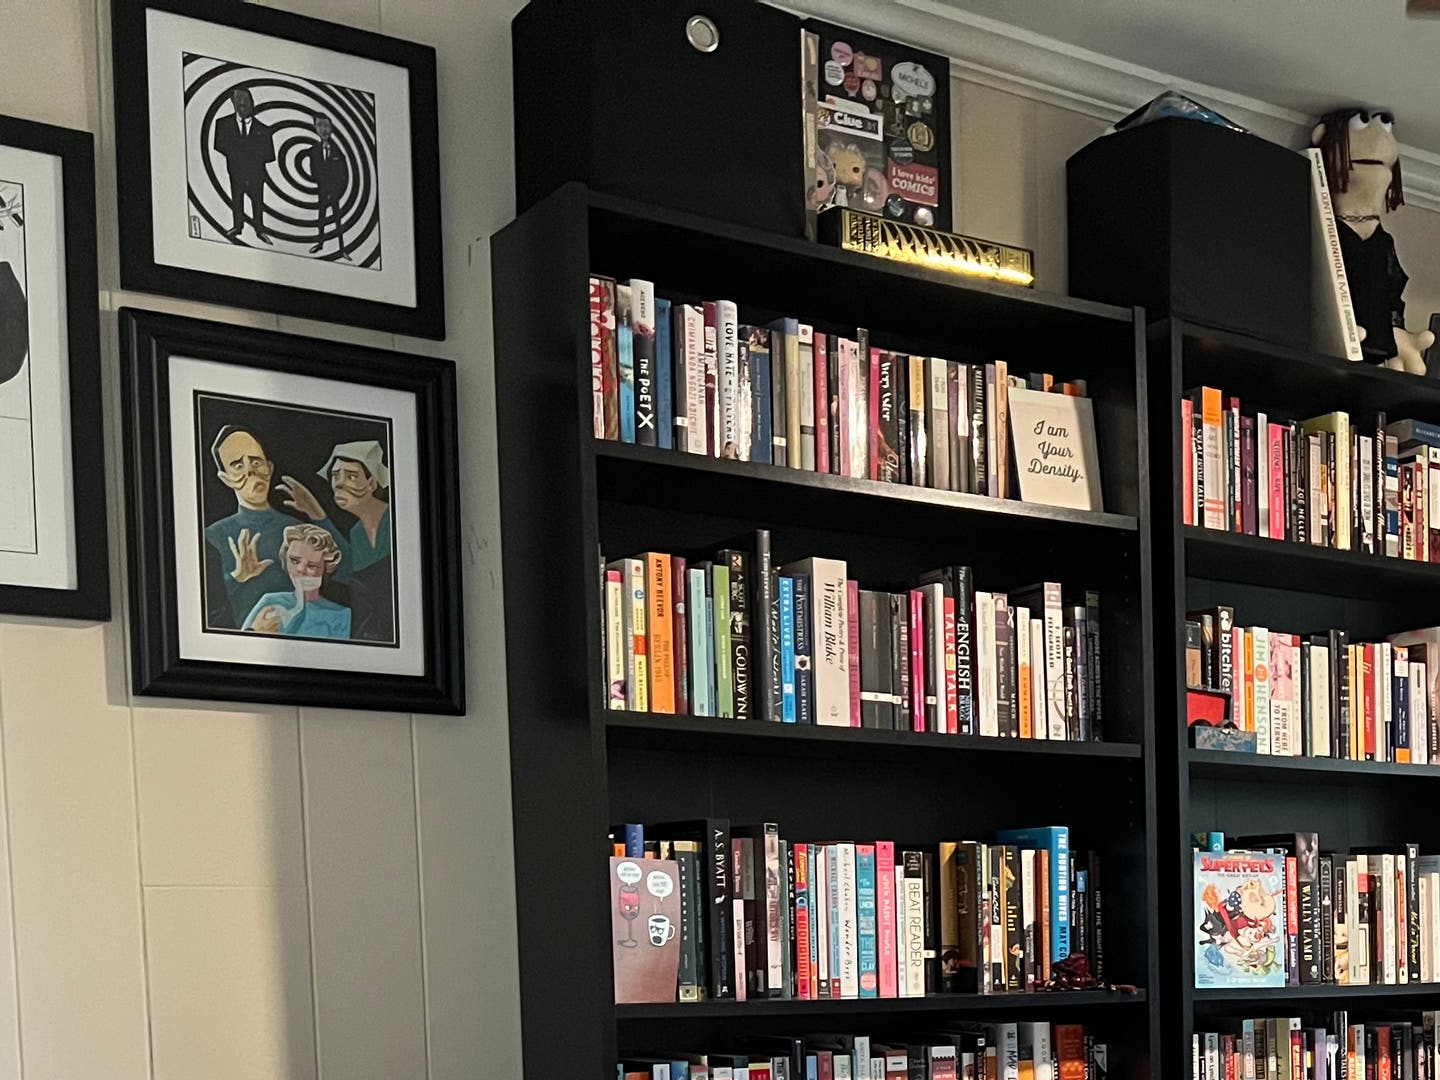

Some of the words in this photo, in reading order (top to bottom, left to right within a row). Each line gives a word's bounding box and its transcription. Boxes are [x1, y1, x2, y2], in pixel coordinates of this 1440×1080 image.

[833, 112, 863, 129] Clue
[892, 177, 936, 197] COMICS
[898, 168, 916, 181] love
[1326, 216, 1345, 280] PIGEONHOLE
[687, 317, 697, 373] CHIMAMANDA
[725, 322, 734, 347] LOVE
[638, 358, 649, 374] THE
[725, 352, 735, 377] HATE
[639, 378, 652, 410] POET
[688, 375, 697, 401] NGOZI
[637, 411, 654, 429] X
[1033, 420, 1046, 438] I
[1047, 425, 1069, 438] am
[1038, 441, 1075, 460] Your
[1028, 459, 1084, 483] Density.
[656, 558, 664, 586] ANTONY
[761, 551, 770, 598] Temptress
[656, 589, 665, 618] BEEVOR
[783, 580, 791, 612] EXTRA
[824, 581, 837, 628] William
[783, 614, 791, 647] LIVES
[795, 594, 806, 650] POSTMISTRESS
[945, 613, 955, 650] TALK
[824, 631, 838, 665] Blake
[957, 623, 970, 689] ENGLISH
[1255, 638, 1266, 662] JIM
[735, 645, 748, 713] GOLDWYN
[1363, 662, 1372, 674] lit
[946, 674, 956, 712] TALK
[1256, 684, 1267, 747] HENSON
[1274, 705, 1281, 714] TO
[714, 828, 723, 840] A.
[714, 841, 723, 851] S.
[1058, 833, 1067, 849] THE
[714, 854, 726, 888] BYATT
[1058, 853, 1067, 890] HUNTING
[909, 882, 921, 911] BEAT
[1058, 895, 1067, 922] WIVES
[1302, 886, 1312, 925] WALLY
[844, 920, 852, 956] Wonder
[910, 916, 922, 968] READER
[1059, 926, 1067, 944] MAY
[1095, 929, 1103, 959] MIGHTY
[1303, 930, 1313, 961] LAMB
[844, 959, 853, 980] Boys
[1096, 960, 1104, 979] FALL
[1008, 1050, 1018, 1069] MAD
